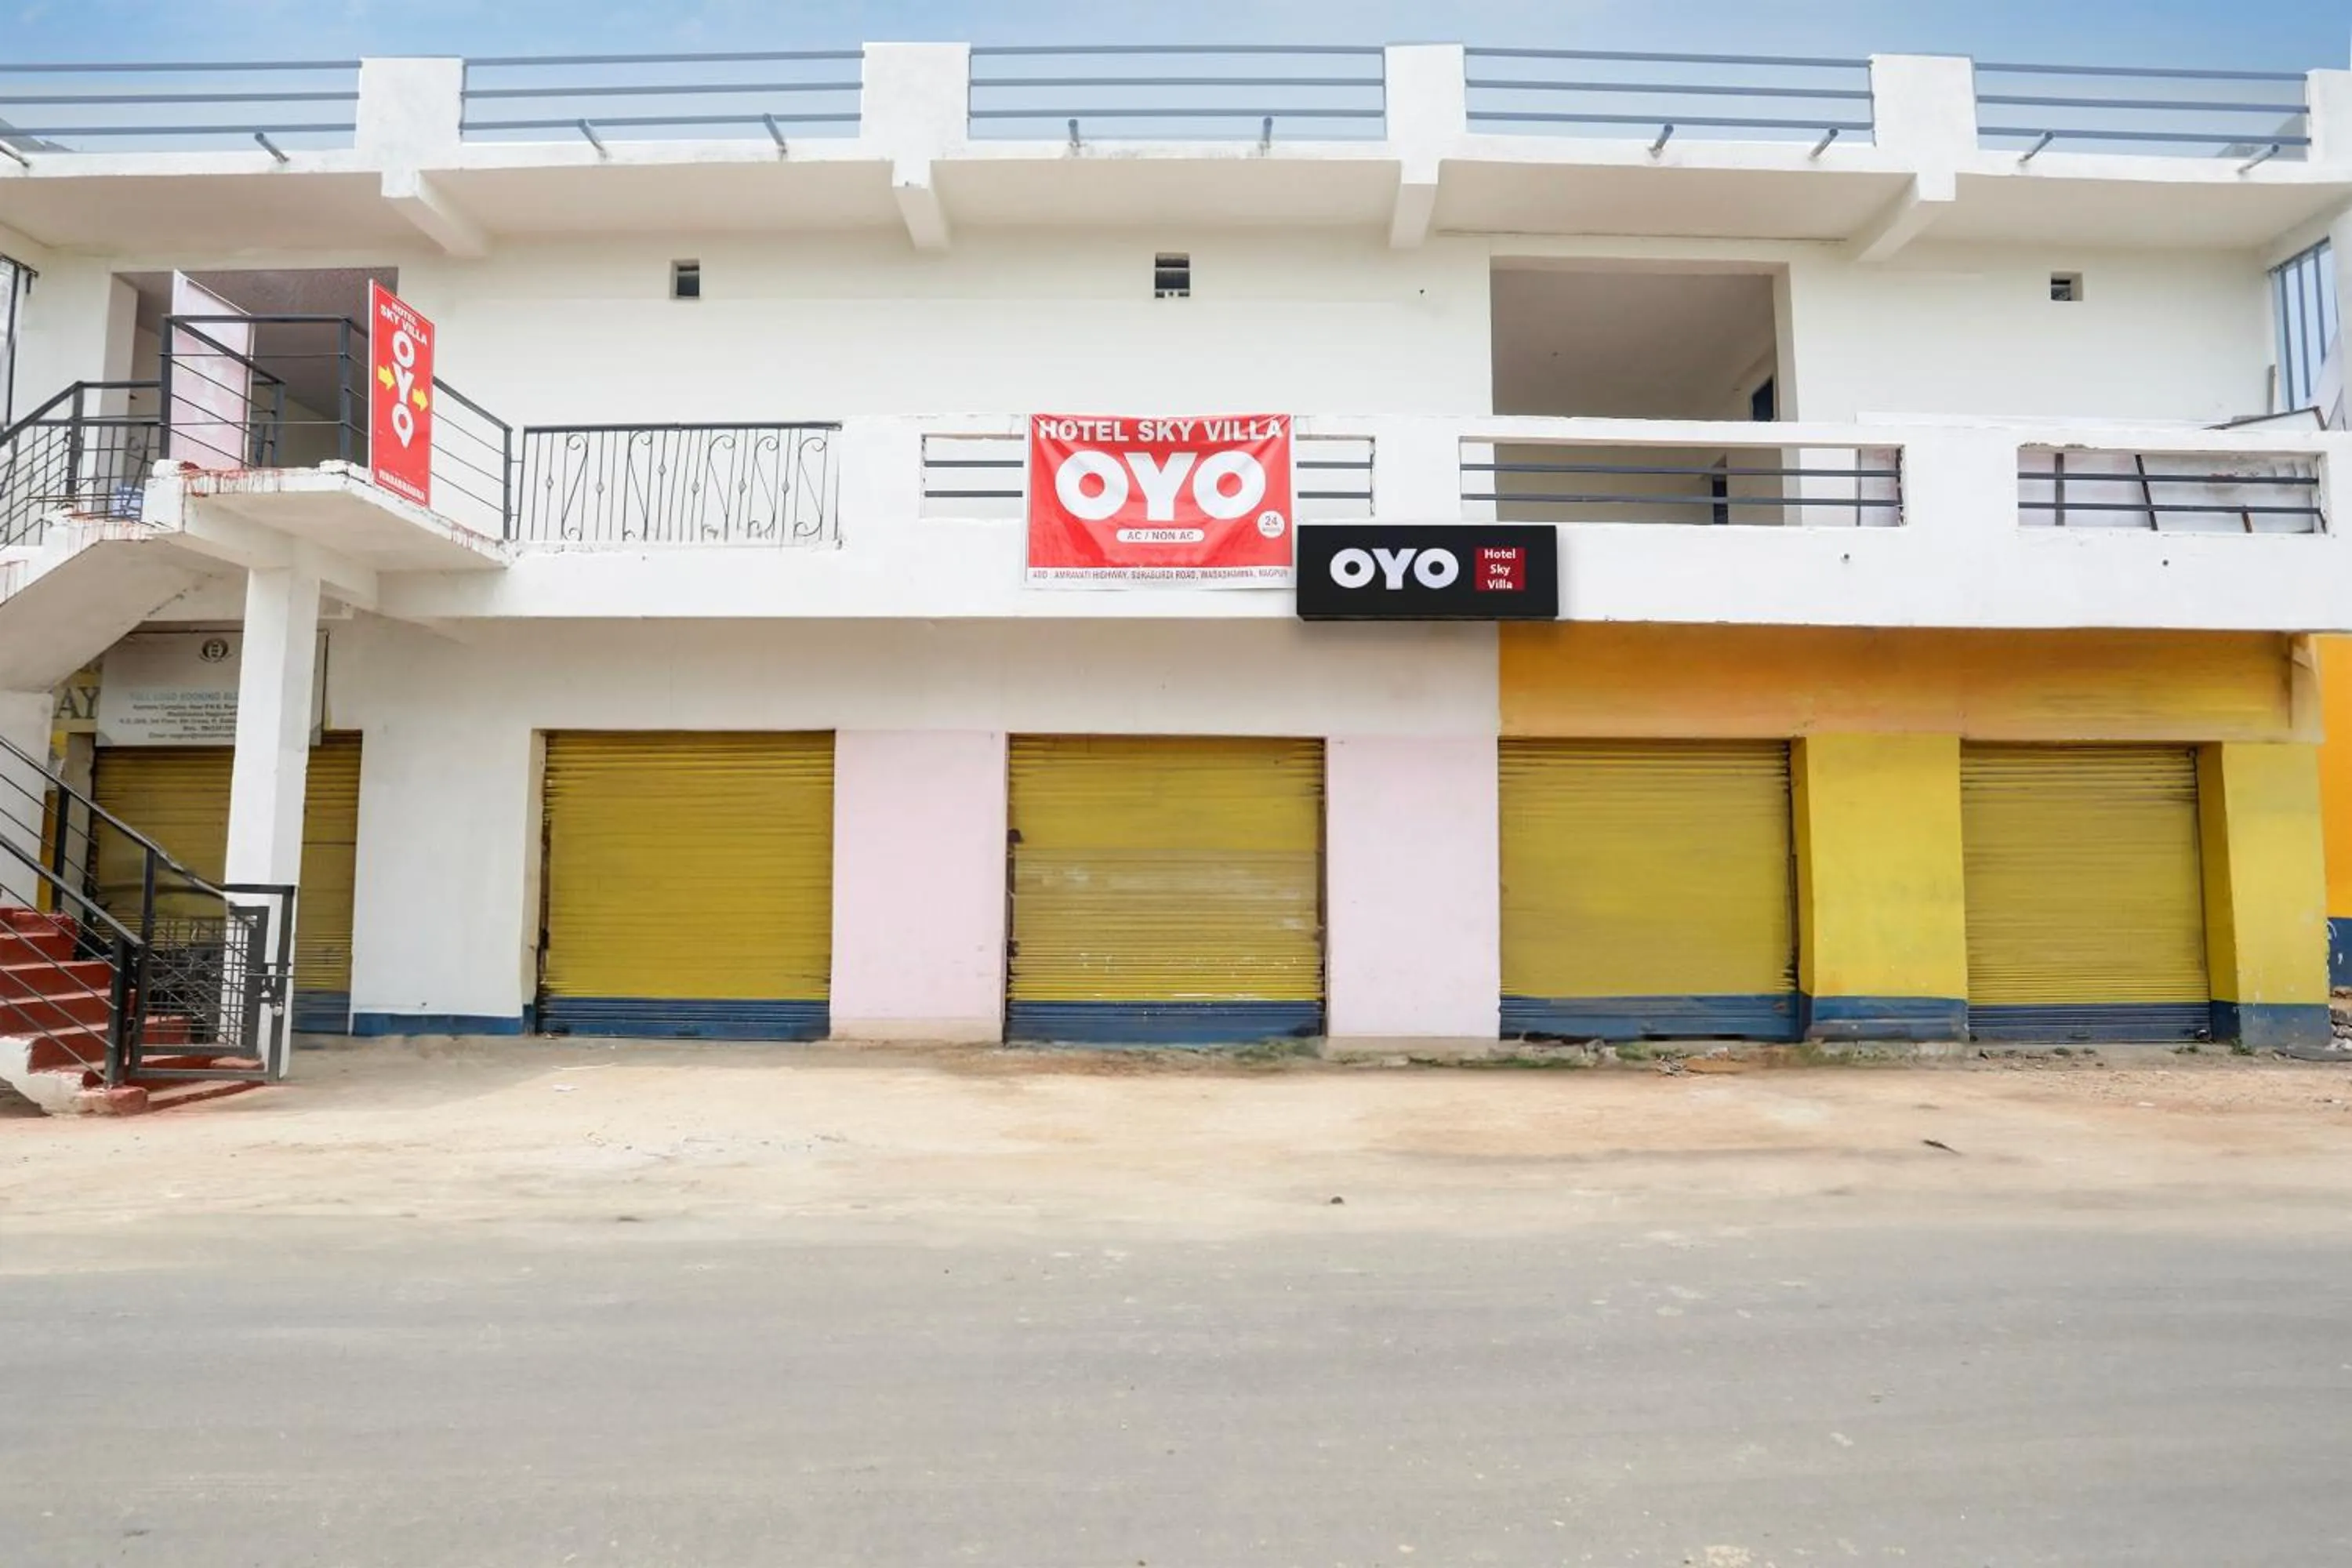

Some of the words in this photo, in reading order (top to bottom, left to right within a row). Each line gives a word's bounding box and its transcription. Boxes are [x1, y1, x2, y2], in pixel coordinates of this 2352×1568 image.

[379, 303, 399, 325] SKY
[401, 317, 427, 345] VILLA
[392, 330, 415, 449] OYO
[1039, 419, 1129, 441] HOTEL
[1138, 420, 1196, 441] SKY
[1203, 419, 1283, 441] VILLA
[1054, 450, 1266, 521] OYO
[1265, 515, 1278, 525] 24
[1127, 531, 1142, 541] AC
[1152, 531, 1175, 540] NON
[1179, 531, 1194, 540] AC
[1484, 549, 1516, 559] Hotel
[1330, 548, 1459, 590] OYO
[1490, 564, 1511, 576] Sky
[1487, 579, 1513, 590] Villa
